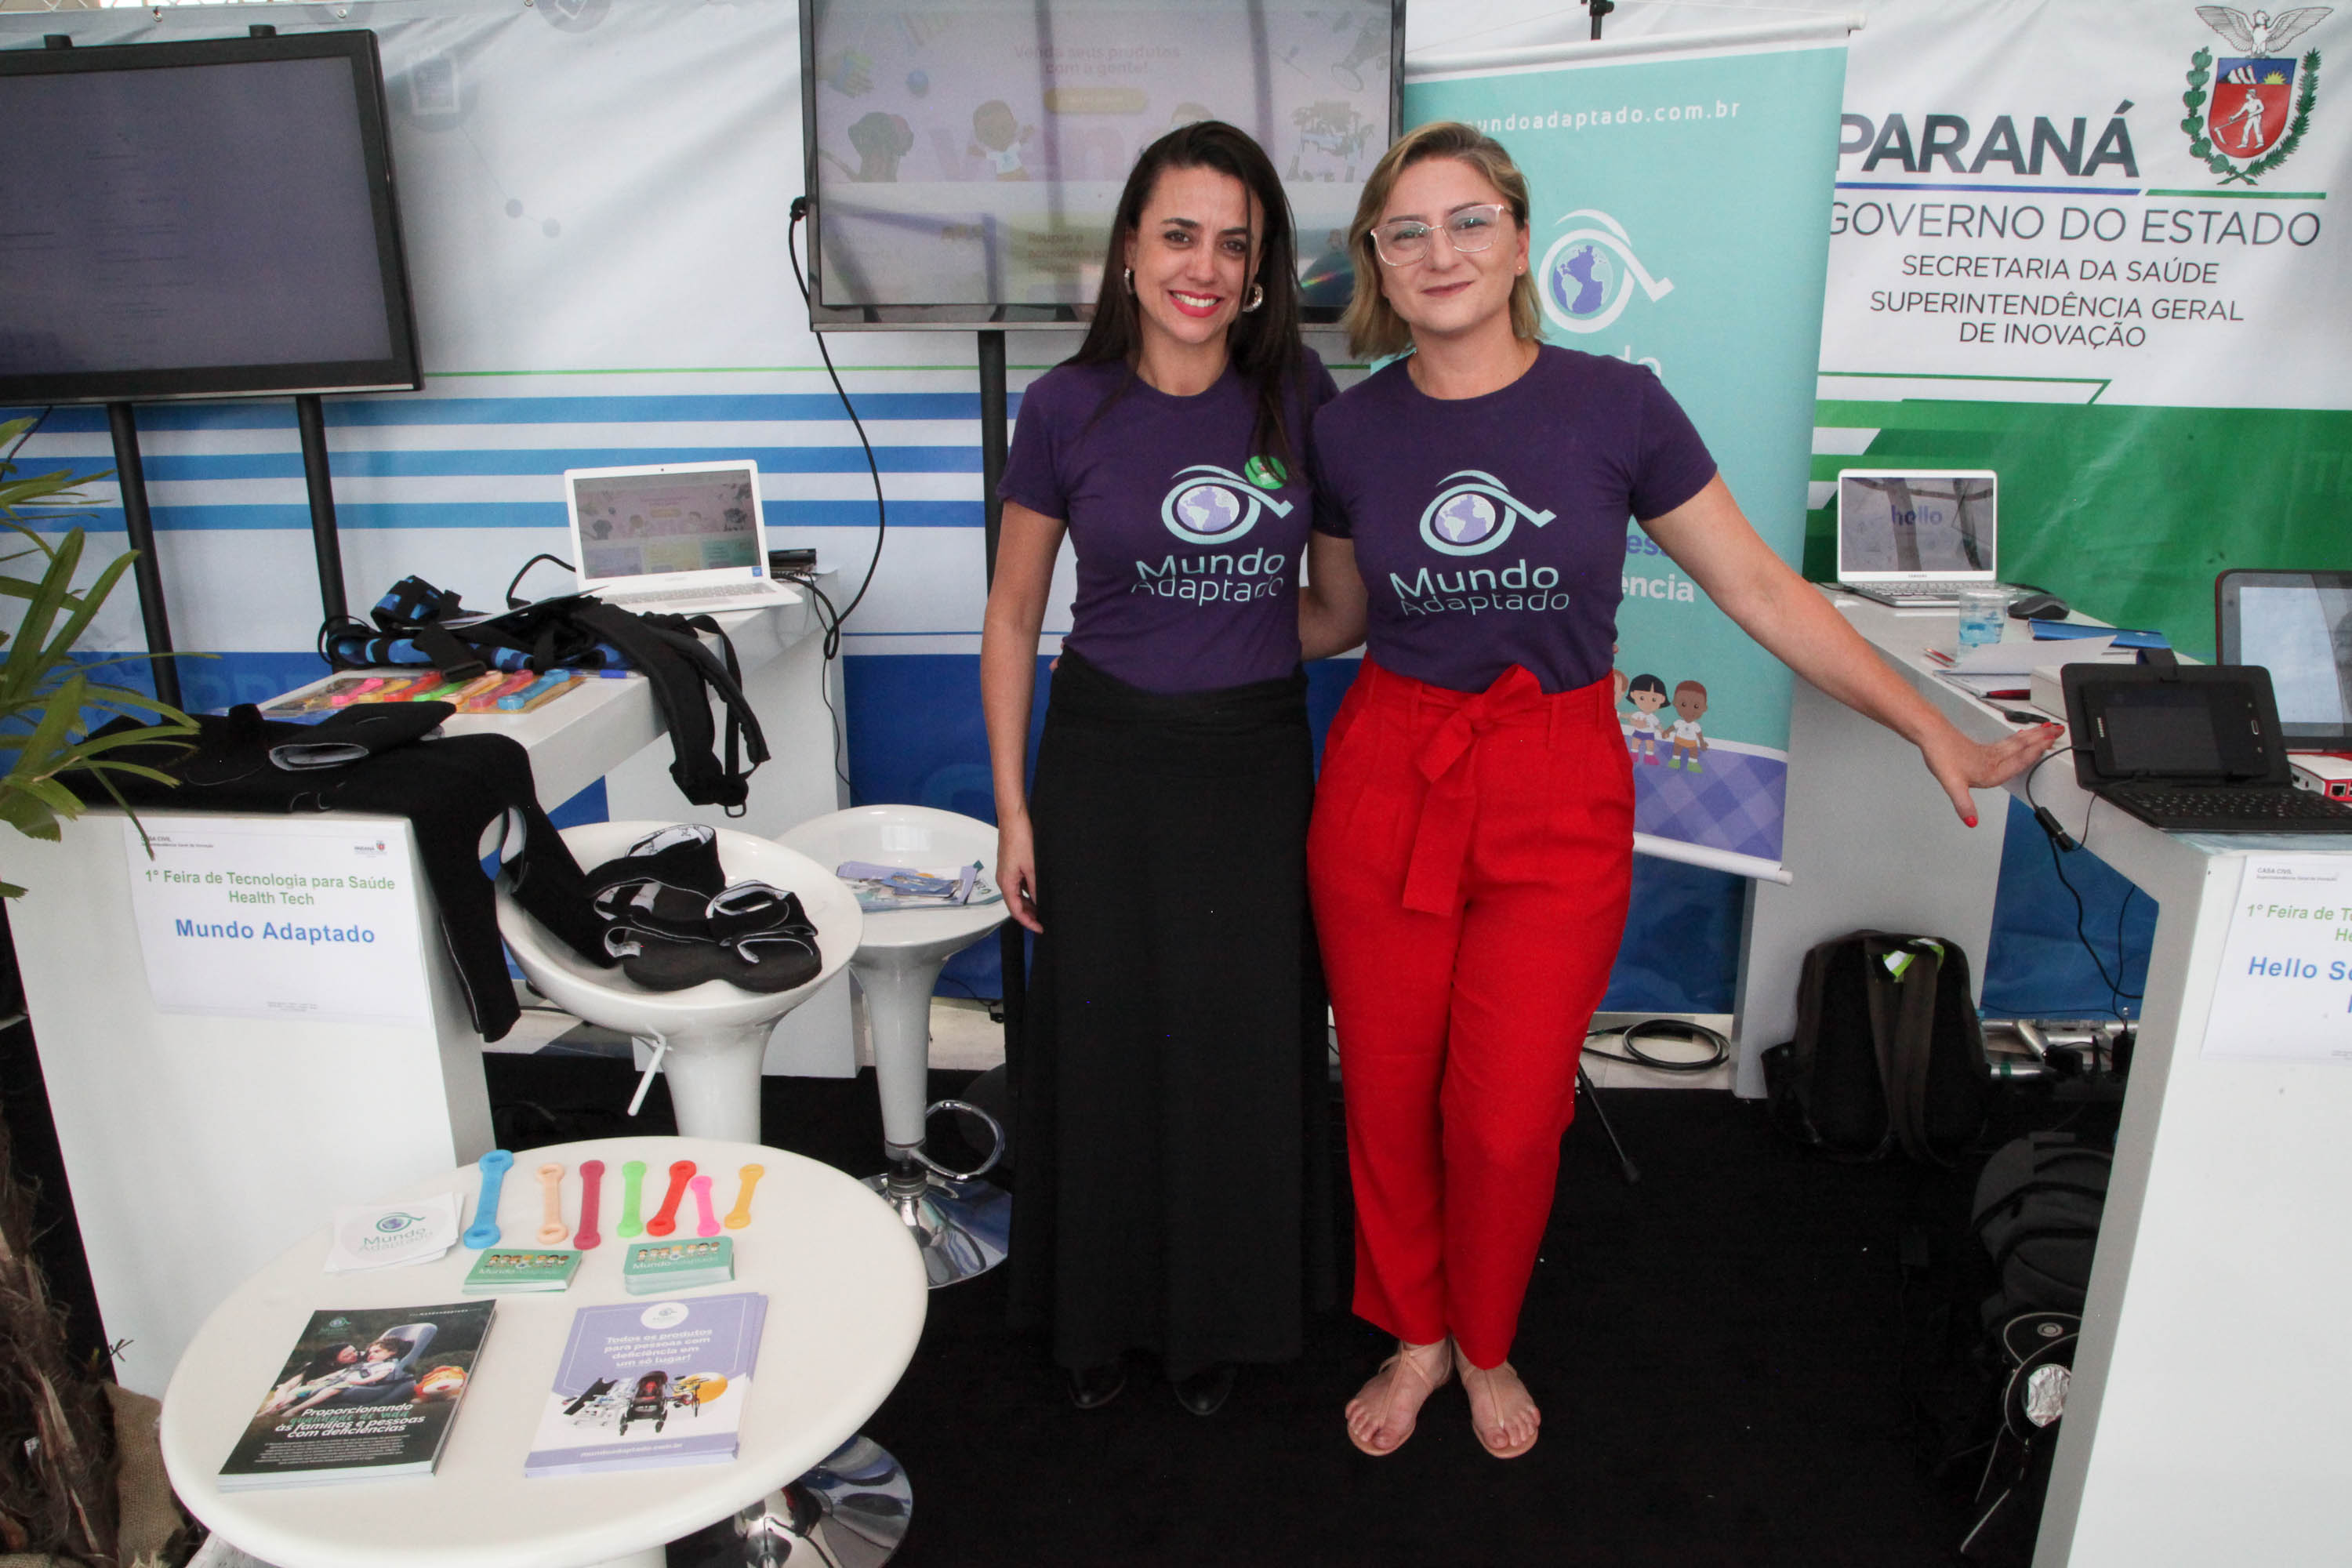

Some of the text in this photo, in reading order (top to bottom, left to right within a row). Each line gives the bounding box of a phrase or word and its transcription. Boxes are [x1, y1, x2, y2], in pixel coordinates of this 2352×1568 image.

[1836, 100, 2139, 177] PARANÁ
[1831, 201, 2321, 247] GOVERNO DO ESTADO
[1902, 255, 2220, 284] SECRETARIA DA SAÚDE
[1870, 291, 2245, 321] SUPERINTENDÊNCIA GERAL
[1959, 321, 2146, 350] DE INOVAÇÃO
[1891, 505, 1944, 526] hello
[1136, 548, 1285, 580] Mundo
[1131, 576, 1283, 606] Adaptado
[1389, 559, 1559, 599] Mundo
[1401, 590, 1569, 615] Adaptado
[164, 870, 200, 884] Feira
[205, 872, 223, 884] de
[227, 872, 307, 888] Tecnologia
[312, 877, 343, 891] para
[349, 875, 395, 890] Saúde
[229, 891, 314, 905] Health Tech
[2267, 905, 2308, 919] Feira
[2314, 906, 2334, 920] de
[176, 919, 375, 945] Mundo Adaptado
[2249, 956, 2318, 978] Hello
[608, 1335, 641, 1344] Todos
[659, 1329, 713, 1341] produtos
[301, 1403, 413, 1417] Proporcionando
[366, 1416, 426, 1428] pessoas
